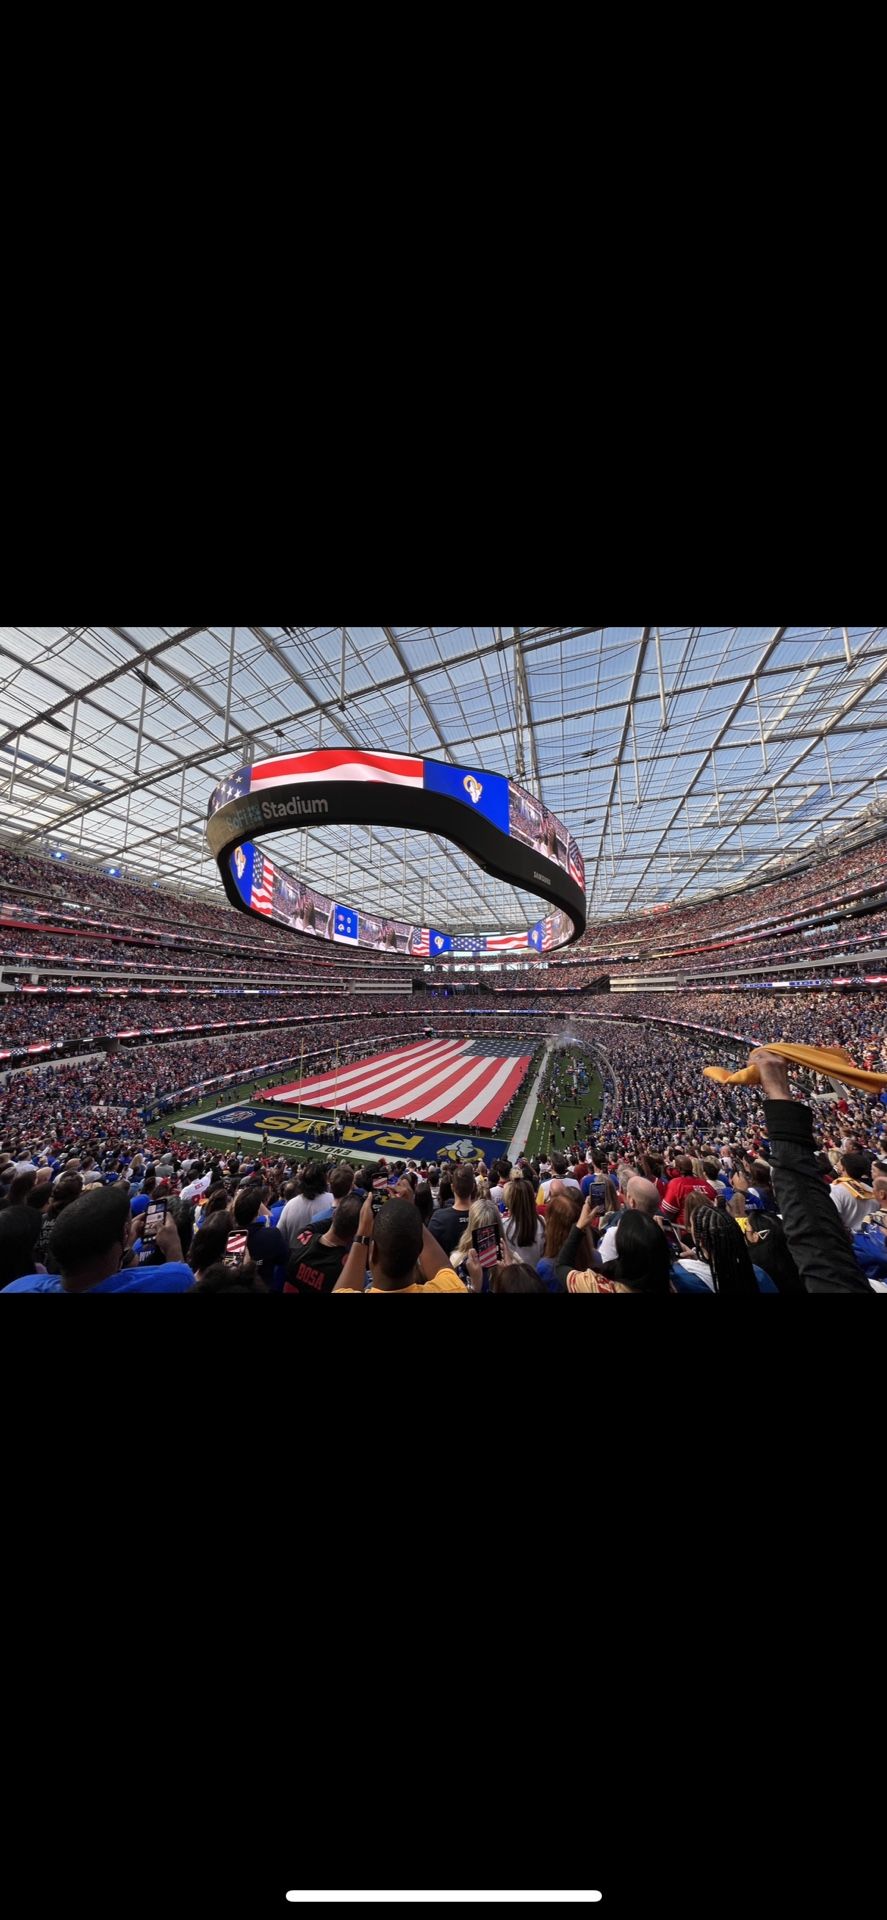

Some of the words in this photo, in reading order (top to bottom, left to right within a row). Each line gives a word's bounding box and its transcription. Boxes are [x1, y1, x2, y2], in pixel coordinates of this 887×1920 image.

[261, 796, 329, 819] Stadium
[324, 1147, 352, 1156] END
[296, 1263, 325, 1290] BOSA
